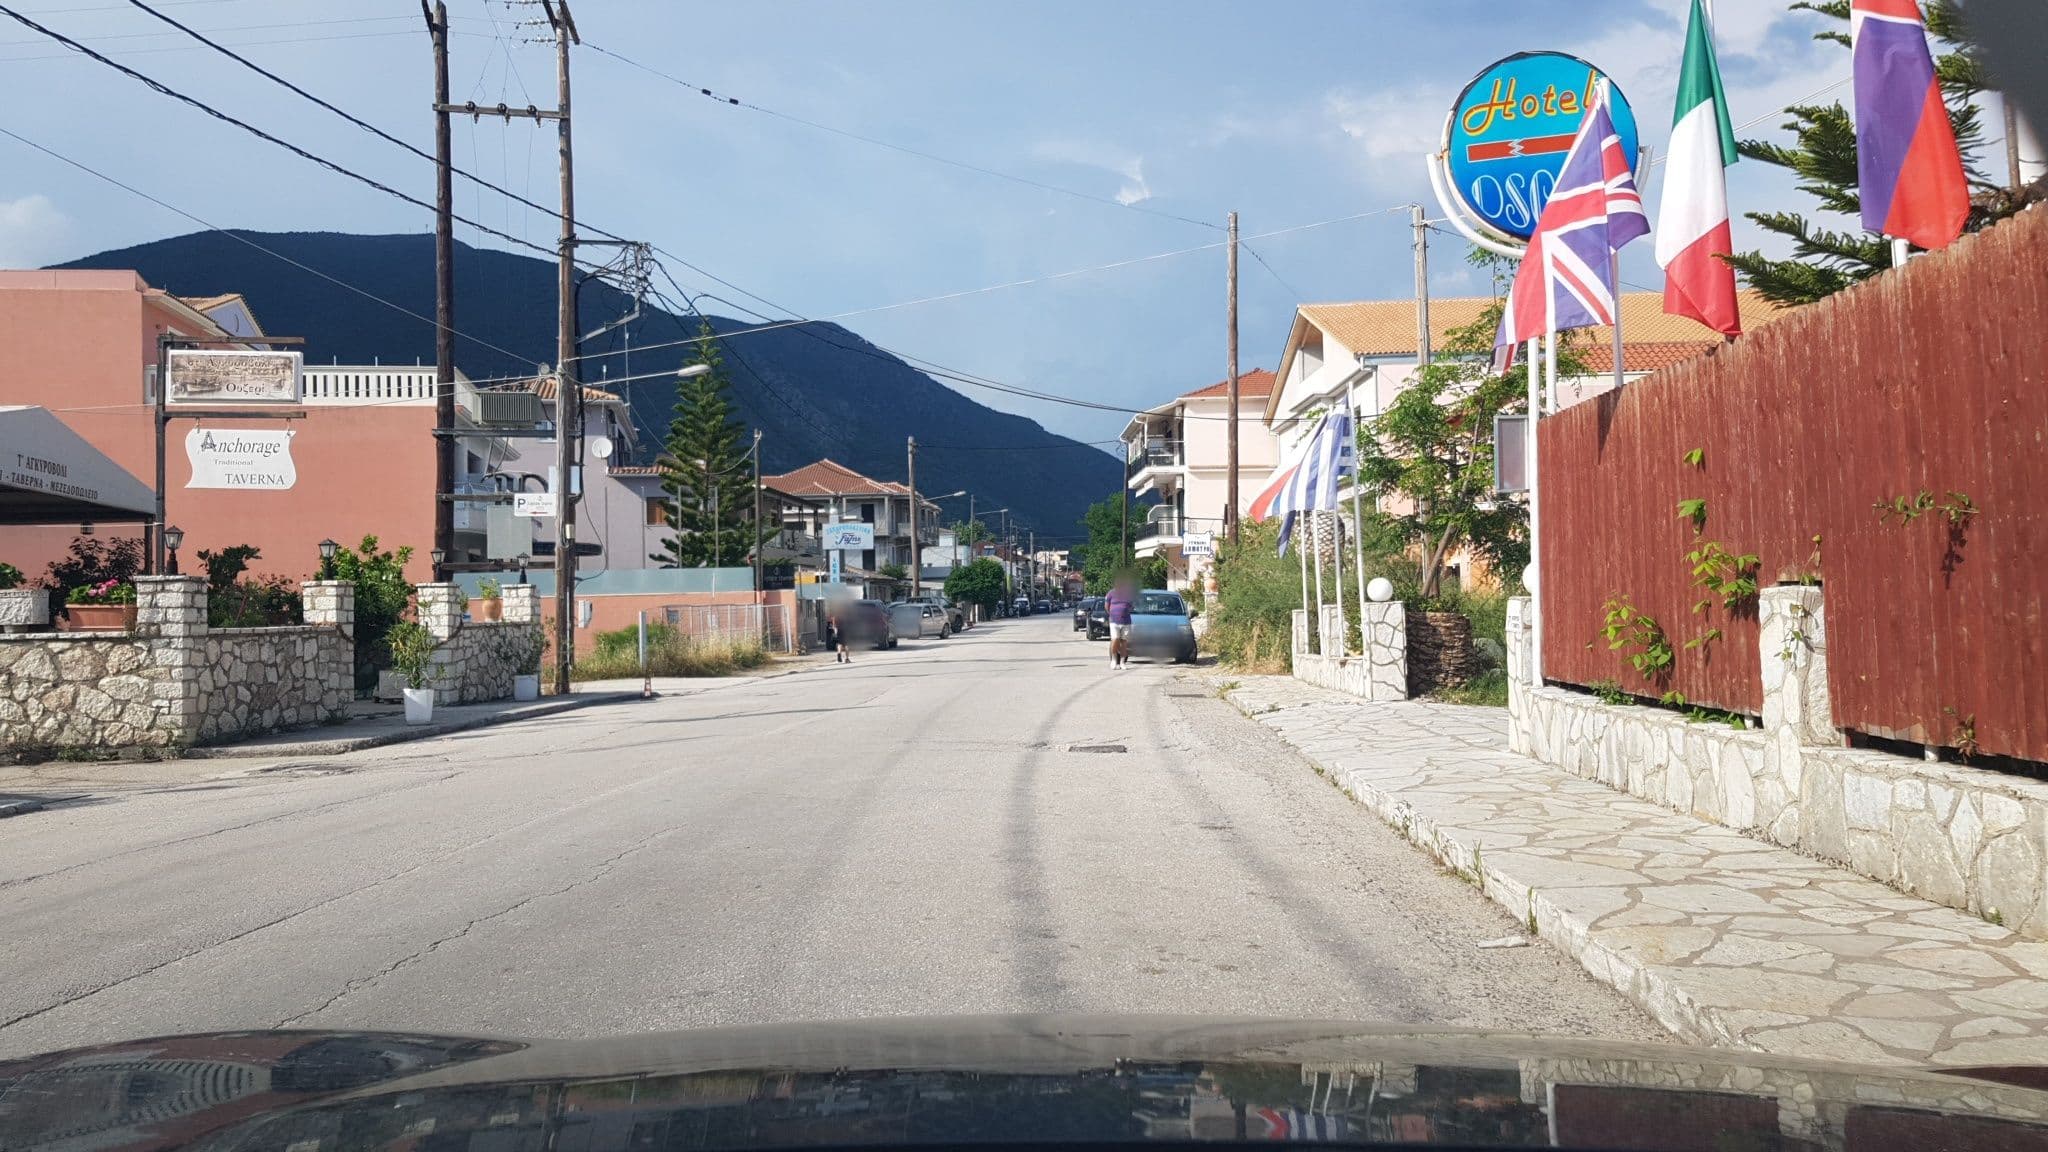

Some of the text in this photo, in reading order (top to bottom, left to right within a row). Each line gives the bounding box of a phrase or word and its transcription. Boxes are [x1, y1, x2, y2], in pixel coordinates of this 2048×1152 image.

[1462, 68, 1598, 134] Hotel
[1471, 169, 1556, 229] OSC
[200, 430, 281, 457] Anchorage
[214, 458, 253, 466] Traditional
[11, 472, 43, 489] ΤΑΒΕΡΝΑ
[225, 473, 285, 486] TAVERNA
[517, 498, 527, 509] P
